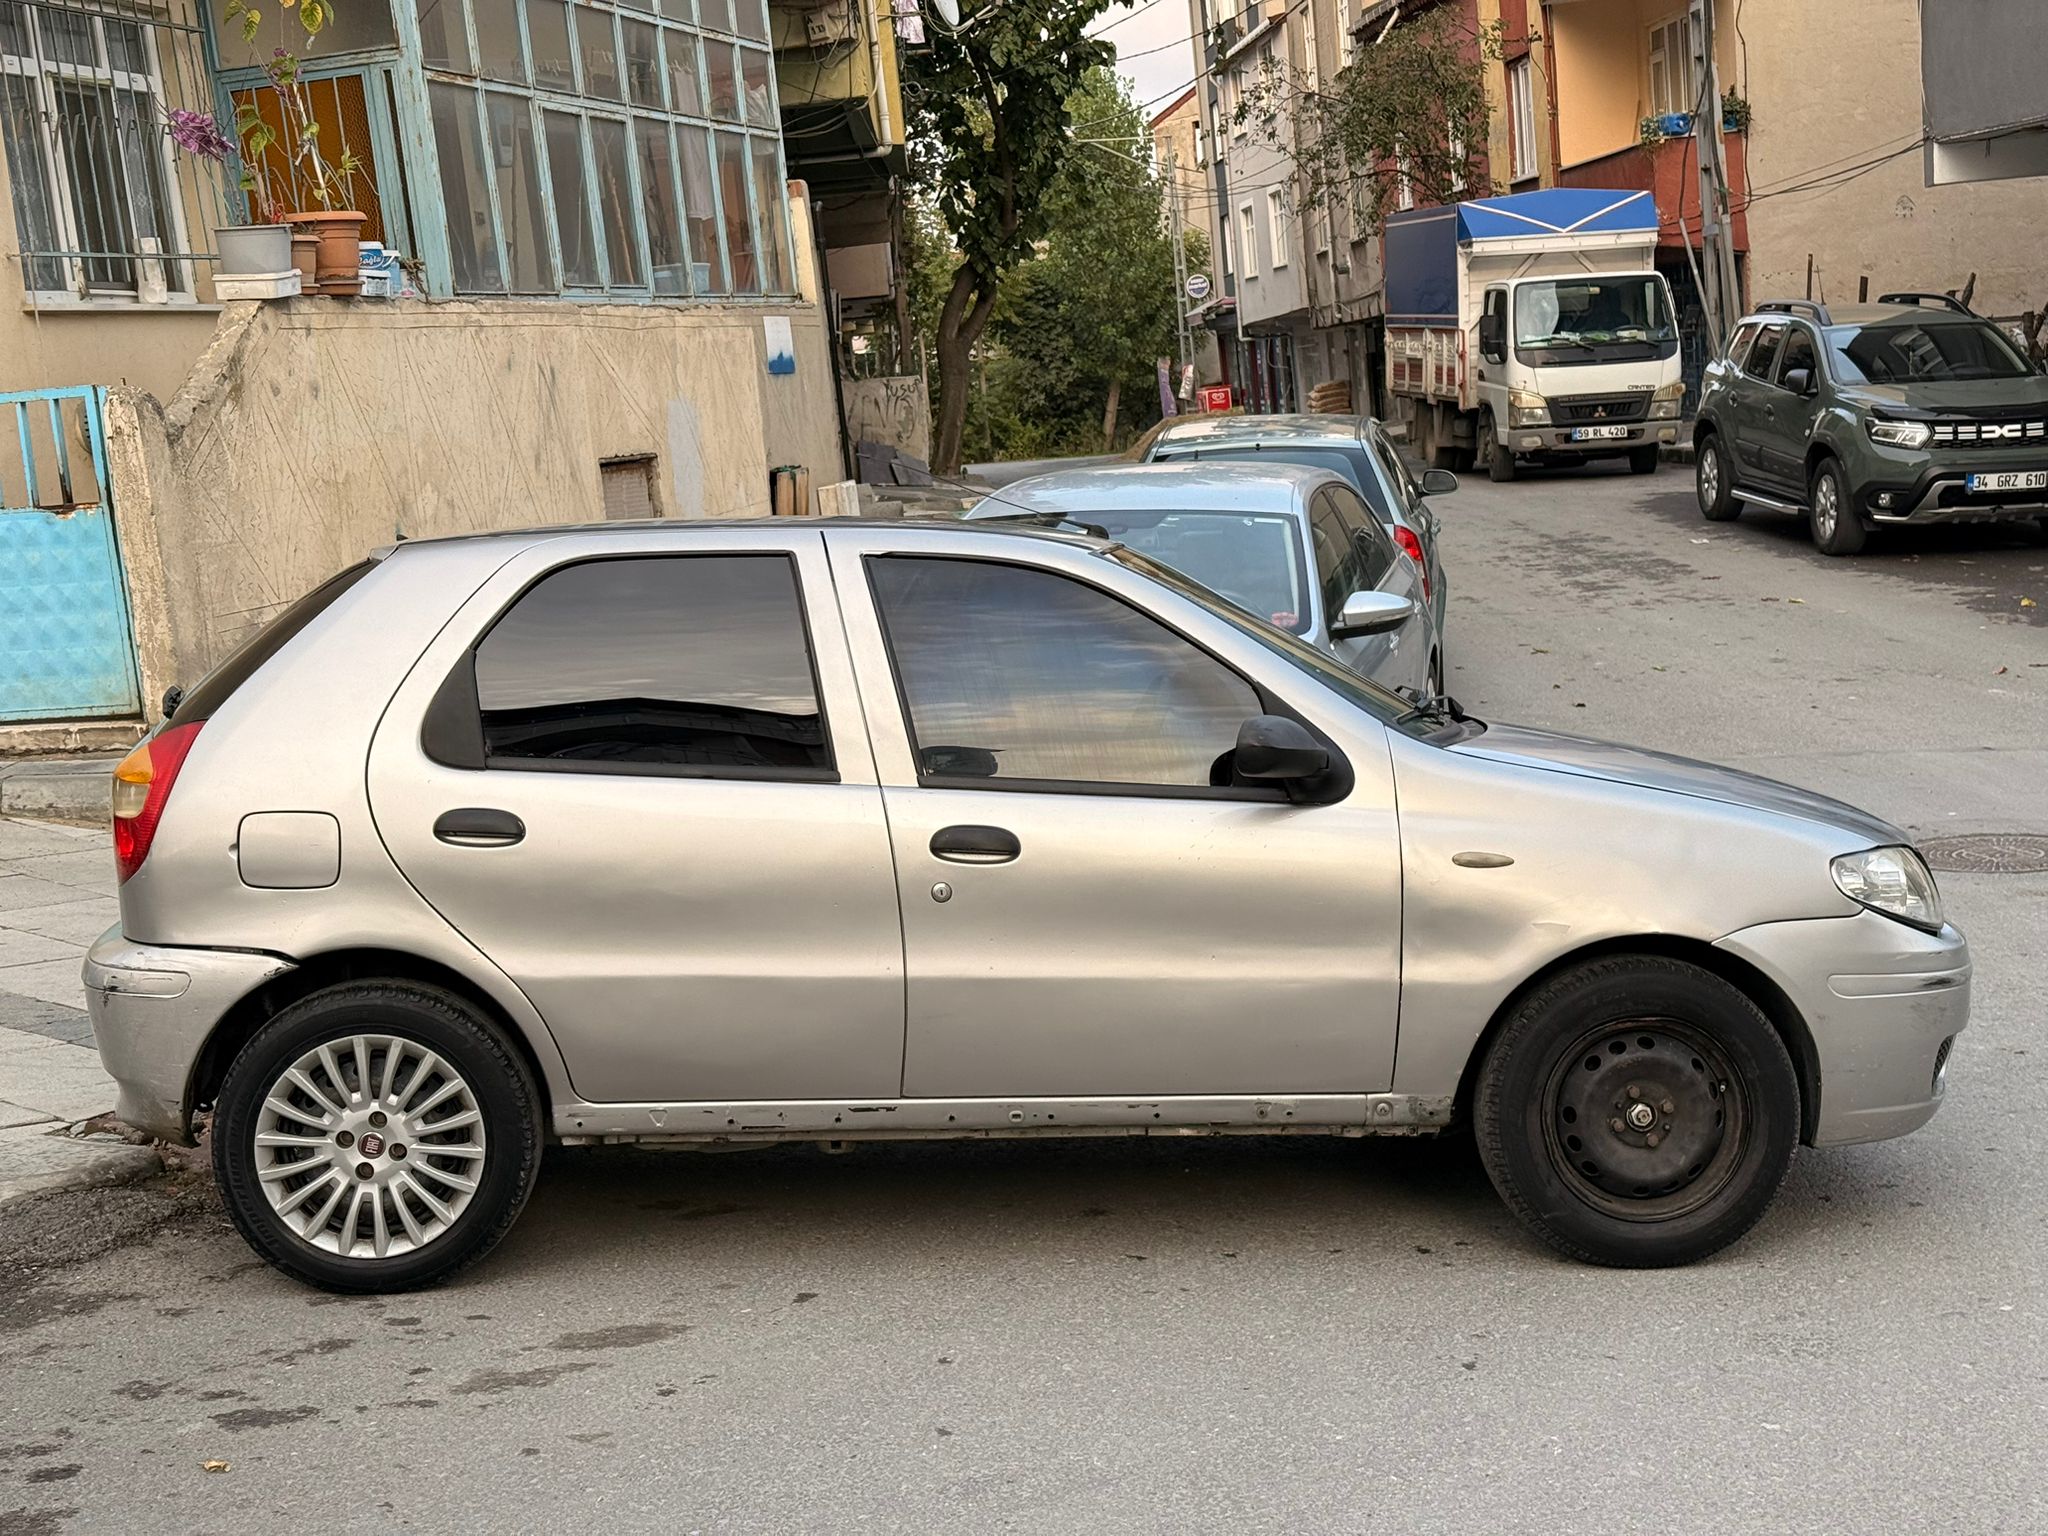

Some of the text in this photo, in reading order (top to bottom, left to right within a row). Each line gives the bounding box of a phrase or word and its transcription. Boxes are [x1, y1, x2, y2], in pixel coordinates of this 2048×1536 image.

[1577, 427, 1626, 437] 59 RL 420
[1974, 473, 2045, 488] 34 GRZ 610
[365, 1136, 380, 1154] FIAT
